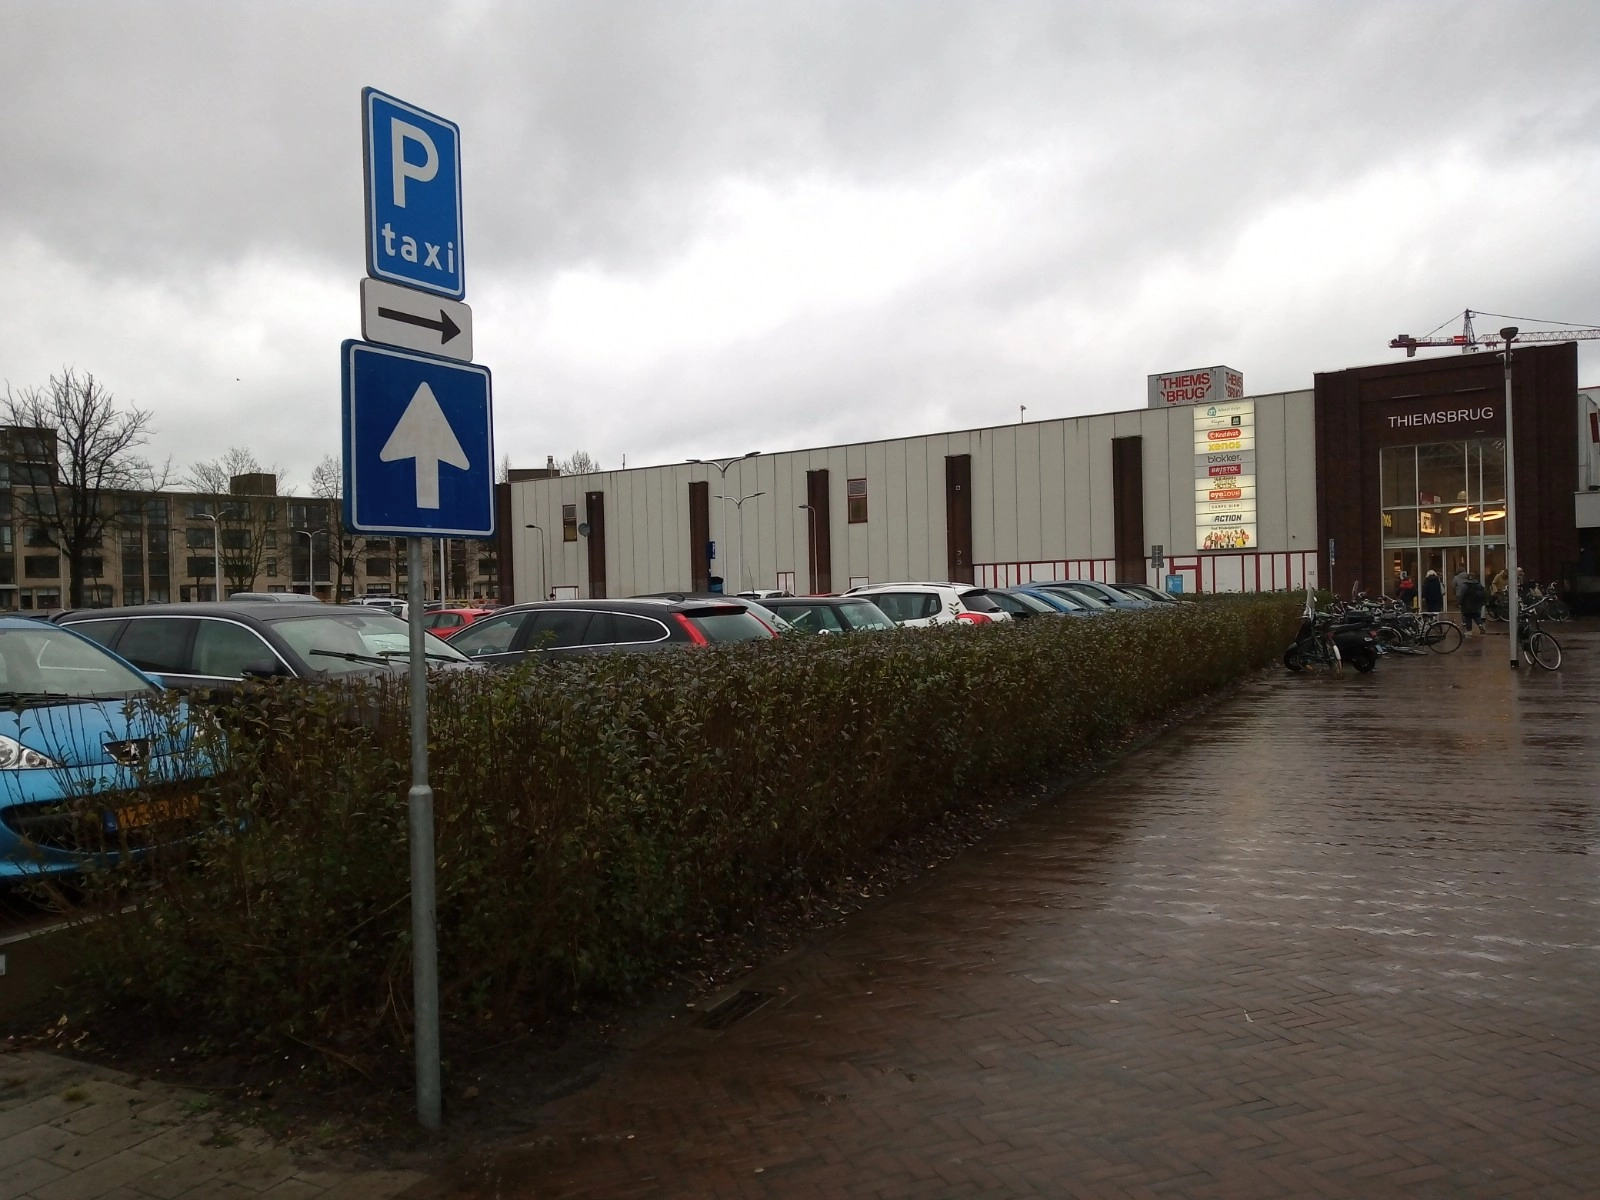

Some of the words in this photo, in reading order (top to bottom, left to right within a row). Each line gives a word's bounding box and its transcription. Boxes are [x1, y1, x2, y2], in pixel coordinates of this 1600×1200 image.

[390, 116, 440, 209] P
[381, 222, 454, 274] taxi
[1161, 373, 1210, 389] THIEMS
[1388, 407, 1494, 428] THIEMSBRUG
[1208, 441, 1241, 451] xenos
[1214, 514, 1242, 522] ACTION
